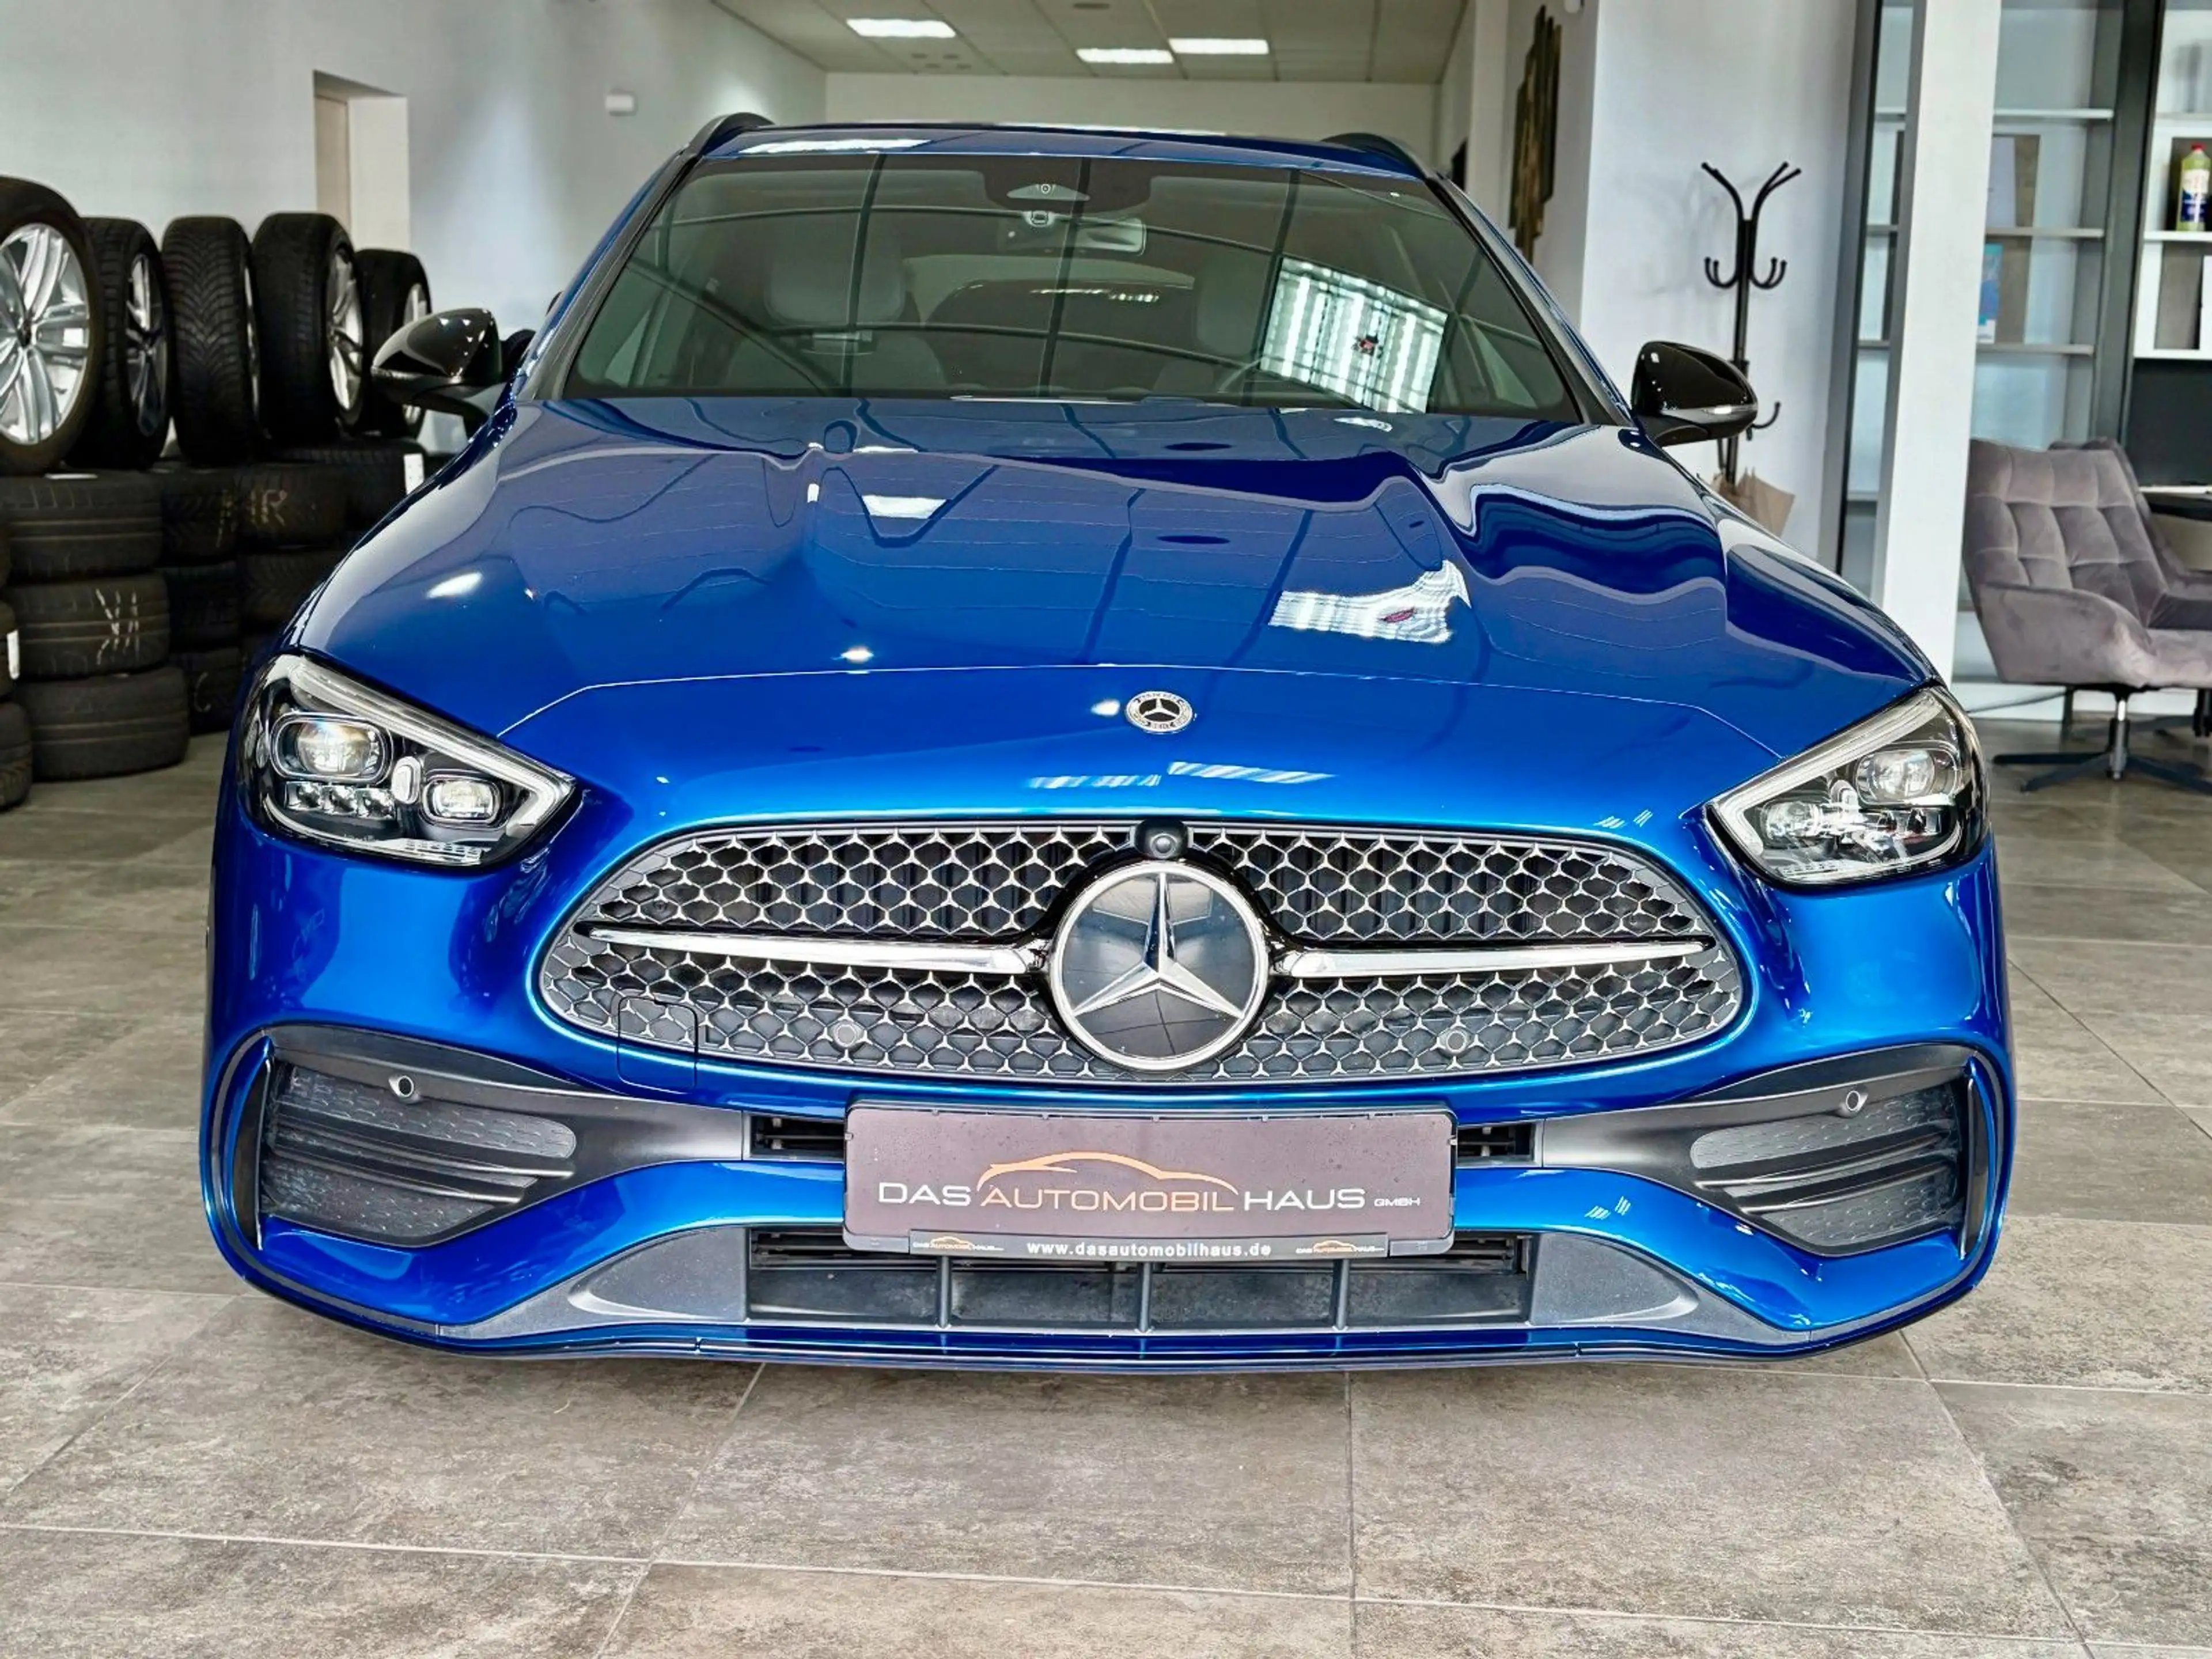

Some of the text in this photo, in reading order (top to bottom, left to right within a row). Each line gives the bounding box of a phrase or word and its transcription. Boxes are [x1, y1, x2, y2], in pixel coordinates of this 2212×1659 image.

[878, 1182, 971, 1206] DAS
[980, 1187, 1234, 1211] AUTOMOBIL
[1244, 1188, 1366, 1211] HAUS
[1027, 1241, 1271, 1257] www.dasautomobilhaus.de
